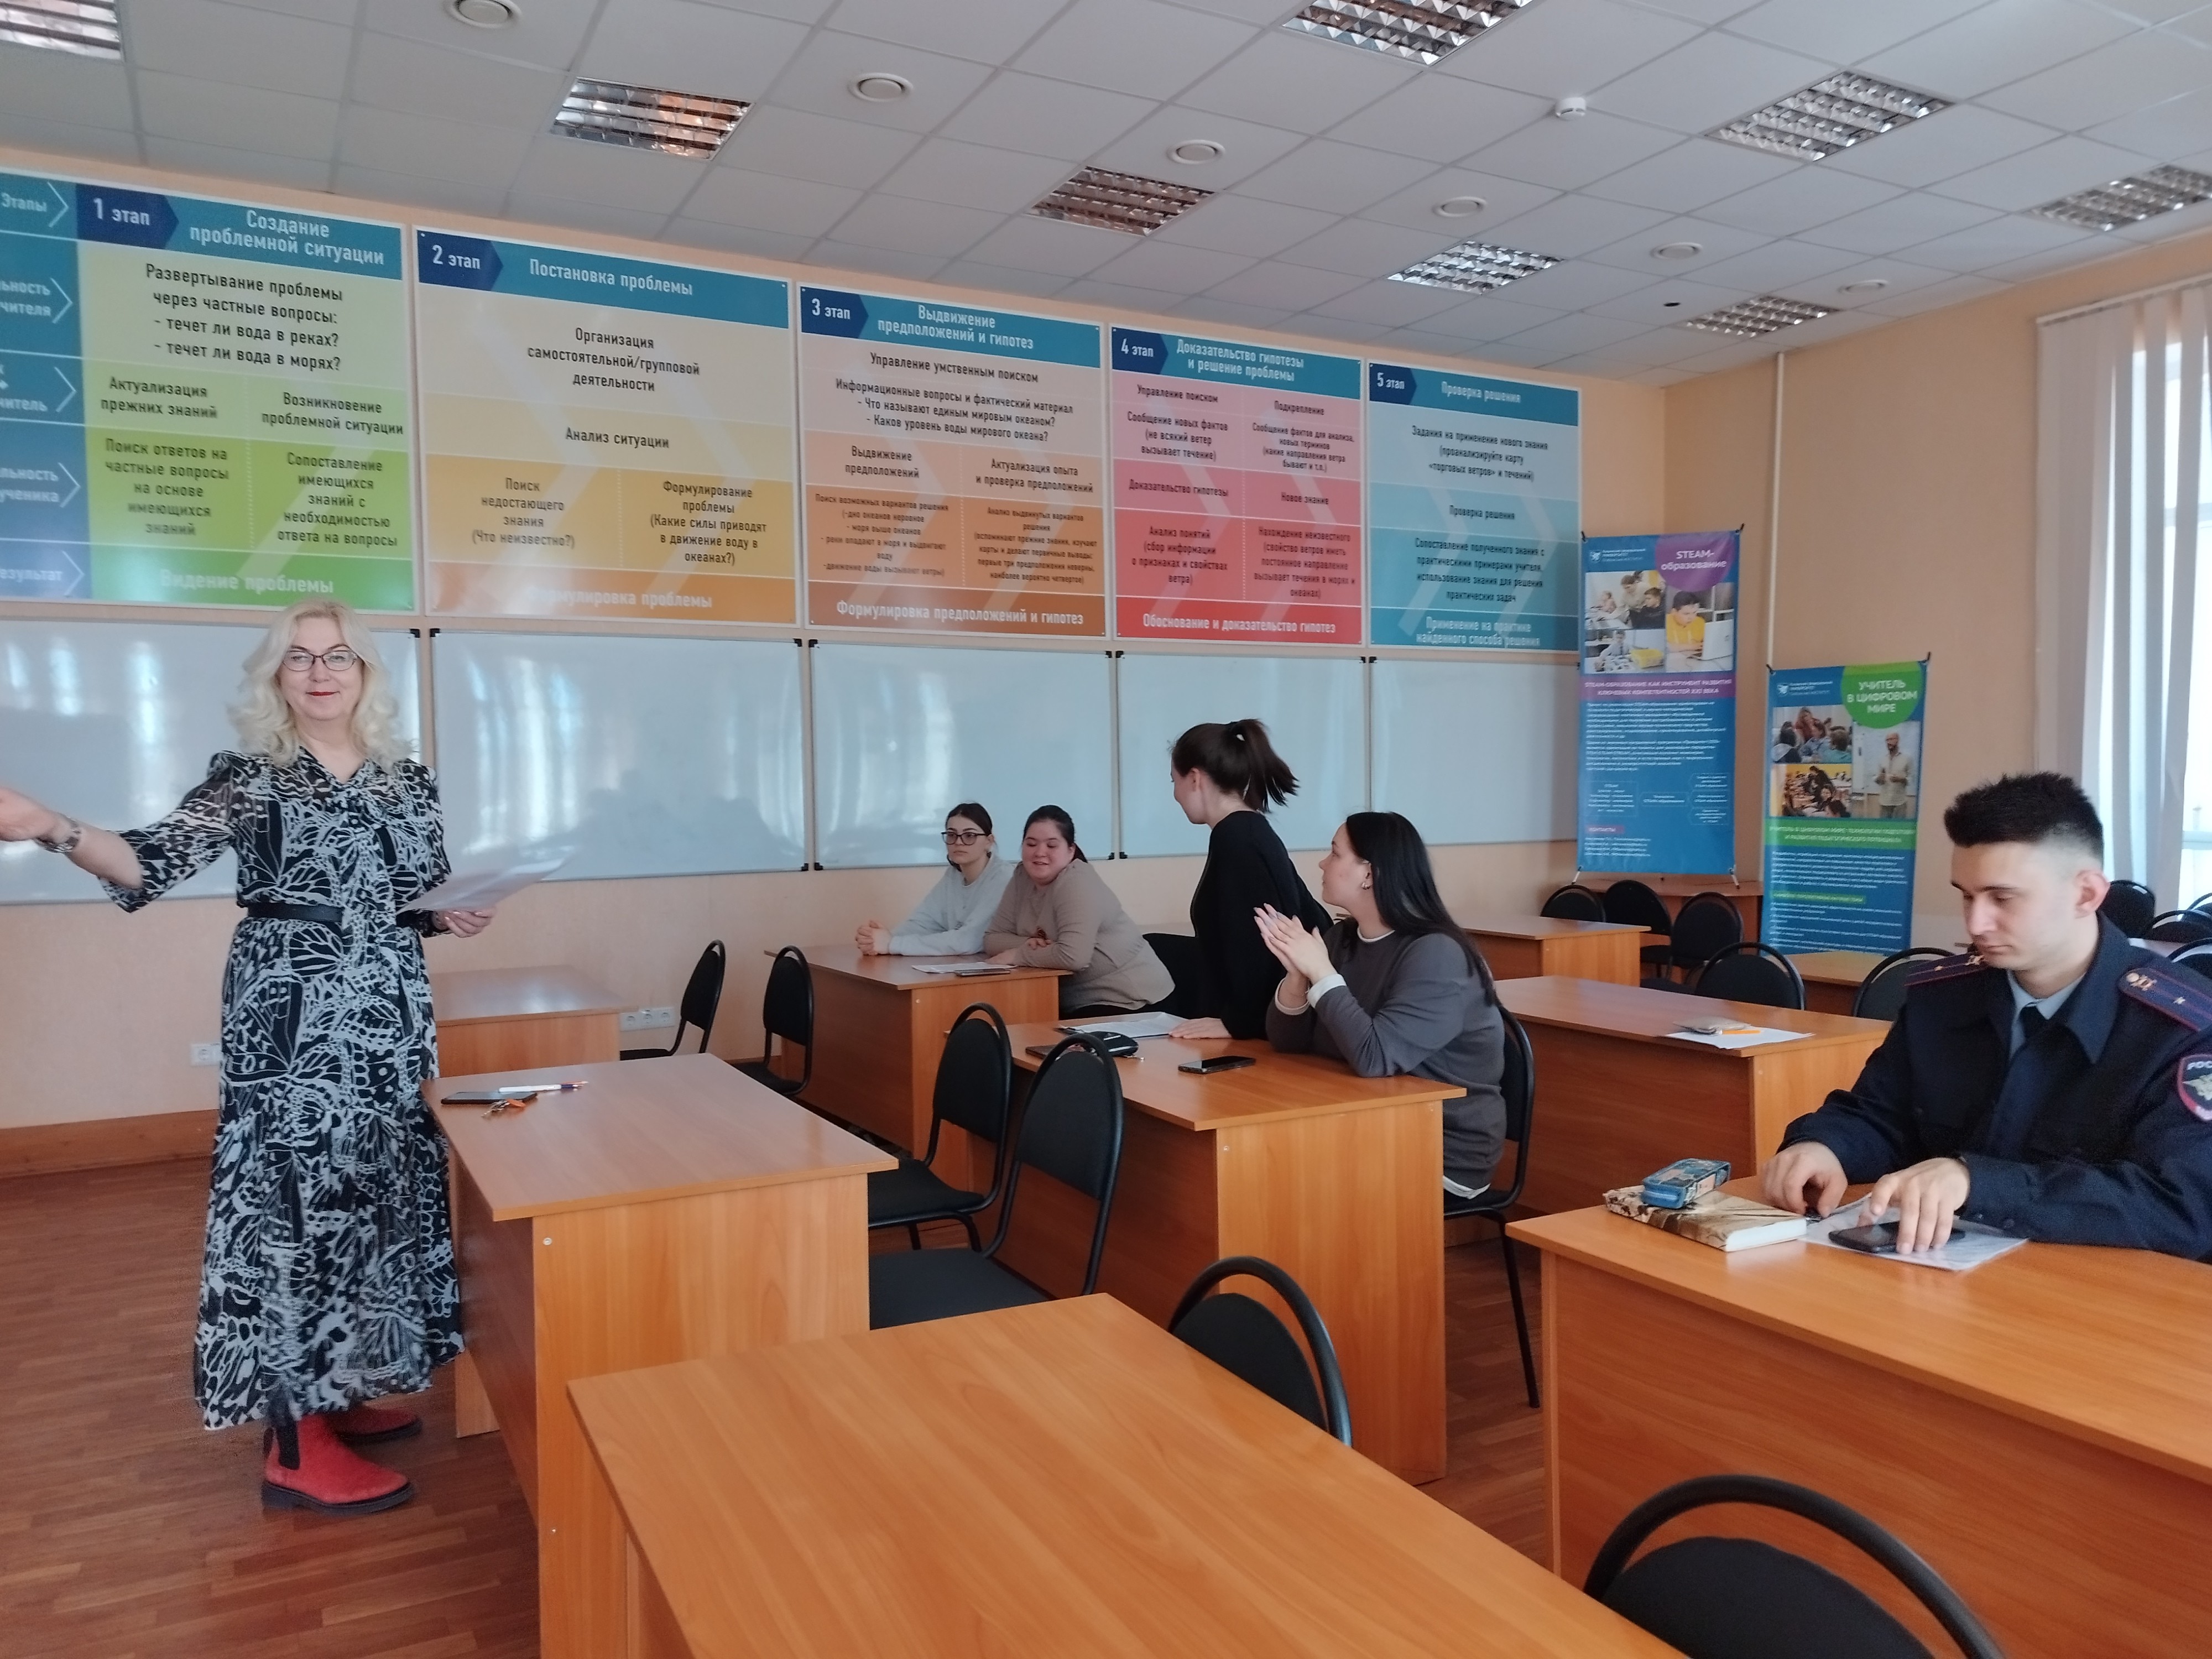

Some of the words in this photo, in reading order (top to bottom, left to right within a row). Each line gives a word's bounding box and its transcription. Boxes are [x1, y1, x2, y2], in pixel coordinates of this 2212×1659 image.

[93, 197, 103, 220] 1
[112, 209, 149, 226] этап
[247, 210, 329, 238] Создание
[190, 227, 298, 255] проблемной
[304, 242, 384, 265] ситуации
[432, 246, 442, 264] 2
[448, 253, 480, 269] этап
[146, 263, 264, 293] Развертывание
[270, 279, 343, 301] проблемы
[530, 259, 615, 285] Постановка
[620, 274, 693, 295] проблемы
[0, 280, 51, 296] ьность
[153, 293, 197, 309] через
[203, 296, 264, 316] частные
[272, 305, 337, 324] вопросы:
[812, 298, 821, 316] 3
[825, 305, 850, 320] этап
[918, 305, 995, 328] Выдвижение
[167, 317, 207, 332] течет
[213, 322, 231, 336] ли
[237, 325, 270, 341] вода
[277, 331, 284, 341] в
[290, 332, 338, 348] реках?
[575, 327, 654, 349] Организация
[878, 319, 974, 342] предположений
[979, 332, 985, 344] и
[990, 333, 1033, 349] гипотез
[167, 341, 207, 358] течет
[213, 346, 231, 359] ли
[237, 349, 270, 365] вода
[277, 355, 284, 364] в
[290, 356, 340, 372] морях?
[1121, 338, 1129, 354] 4
[1132, 345, 1154, 357] этап
[1177, 340, 1256, 361] Доказательство
[1259, 353, 1303, 368] гипотезы
[528, 346, 700, 375] самостоятельной/групповой
[870, 352, 930, 371] Управление
[934, 363, 995, 378] умственным
[998, 369, 1039, 383] поиском
[1198, 360, 1242, 374] решение
[1246, 367, 1294, 381] проблемы
[110, 376, 207, 400] Актуализация
[573, 373, 655, 392] деятельности
[1377, 372, 1384, 387] 5
[1386, 378, 1404, 389] этап
[836, 379, 920, 397] Информационные
[924, 390, 962, 402] вопросы
[974, 393, 1030, 409] фактический
[1034, 400, 1073, 413] материал
[1137, 385, 1183, 400] Управление
[1186, 393, 1218, 403] поиском
[1442, 381, 1481, 400] Проверка
[1484, 389, 1521, 403] решения
[101, 398, 161, 416] прежних
[168, 404, 217, 419] знаний
[283, 393, 382, 413] Возникновение
[865, 398, 880, 410] Что
[884, 401, 930, 414] называют
[933, 407, 968, 419] единым
[972, 410, 1012, 423] мировым
[1015, 416, 1055, 426] океаном?
[1274, 400, 1324, 416] Подкрепление
[262, 412, 340, 430] проблемной
[346, 420, 403, 435] ситуации
[874, 416, 901, 427] Каков
[905, 420, 941, 431] уровень
[945, 423, 967, 434] воды
[971, 426, 1011, 439] мирового
[1014, 431, 1048, 442] океана?
[1128, 411, 1172, 425] Сообщение
[1175, 418, 1198, 428] новых
[1201, 419, 1228, 430] фактов
[565, 427, 609, 444] Анализ
[614, 434, 669, 448] ситуации
[106, 439, 148, 453] Поиск
[153, 442, 206, 460] ответов
[212, 449, 227, 460] на
[852, 445, 912, 461] Выдвижение
[106, 461, 164, 476] частные
[170, 465, 229, 480] вопросы
[287, 452, 383, 472] Сопоставление
[846, 465, 919, 478] предположений
[992, 458, 1050, 474] Актуализация
[1053, 466, 1078, 476] опыта
[134, 482, 150, 493] на
[156, 484, 204, 497] основе
[299, 475, 373, 491] имеющихся
[505, 478, 540, 492] Поиск
[664, 481, 753, 498] Формулирование
[984, 476, 1024, 489] проверка
[1028, 479, 1093, 493] предположений
[1129, 479, 1191, 493] Доказательство
[1193, 486, 1229, 497] гипотезы
[308, 492, 353, 507] знаний
[359, 497, 366, 507] с
[481, 498, 564, 512] недостающего
[682, 500, 734, 513] проблемы
[1281, 492, 1302, 502] Новое
[128, 503, 211, 519] имеющихся
[284, 510, 390, 528] необходимостью
[1449, 505, 1482, 520] Проверка
[145, 522, 195, 535] знаний
[503, 515, 544, 528] знания
[650, 514, 686, 529] (Какие
[690, 518, 716, 530] силы
[720, 520, 766, 533] приводят
[278, 529, 319, 543] ответа
[324, 532, 338, 543] на
[344, 534, 398, 547] вопросы
[472, 530, 495, 544] (Что
[500, 533, 575, 549] неизвестно?)
[660, 534, 665, 543] в
[670, 534, 722, 547] движение
[726, 537, 748, 550] воду
[753, 539, 758, 547] в
[1149, 526, 1177, 537] Анализ
[1180, 529, 1210, 539] понятий
[685, 551, 735, 565] океанах?)
[1676, 550, 1714, 559] STEAM-
[1661, 560, 1726, 571] образование
[161, 569, 238, 590] Видение
[245, 574, 333, 593] проблемы
[1168, 574, 1192, 585] ветра)
[641, 589, 712, 608] проблемы
[837, 600, 930, 619] Формулировка
[933, 606, 1026, 623] предположений
[1031, 612, 1038, 622] и
[1041, 613, 1083, 625] гипотез
[1143, 613, 1209, 629] Обоснование
[1213, 619, 1219, 628] и
[1222, 620, 1296, 632] доказательство
[1300, 623, 1335, 633] гипотез
[1859, 680, 1906, 690] УЧИТЕЛЬ
[1847, 694, 1855, 702] В
[1856, 691, 1918, 702] ЦИФРОВОМ
[1867, 703, 1896, 713] МИРЕ
